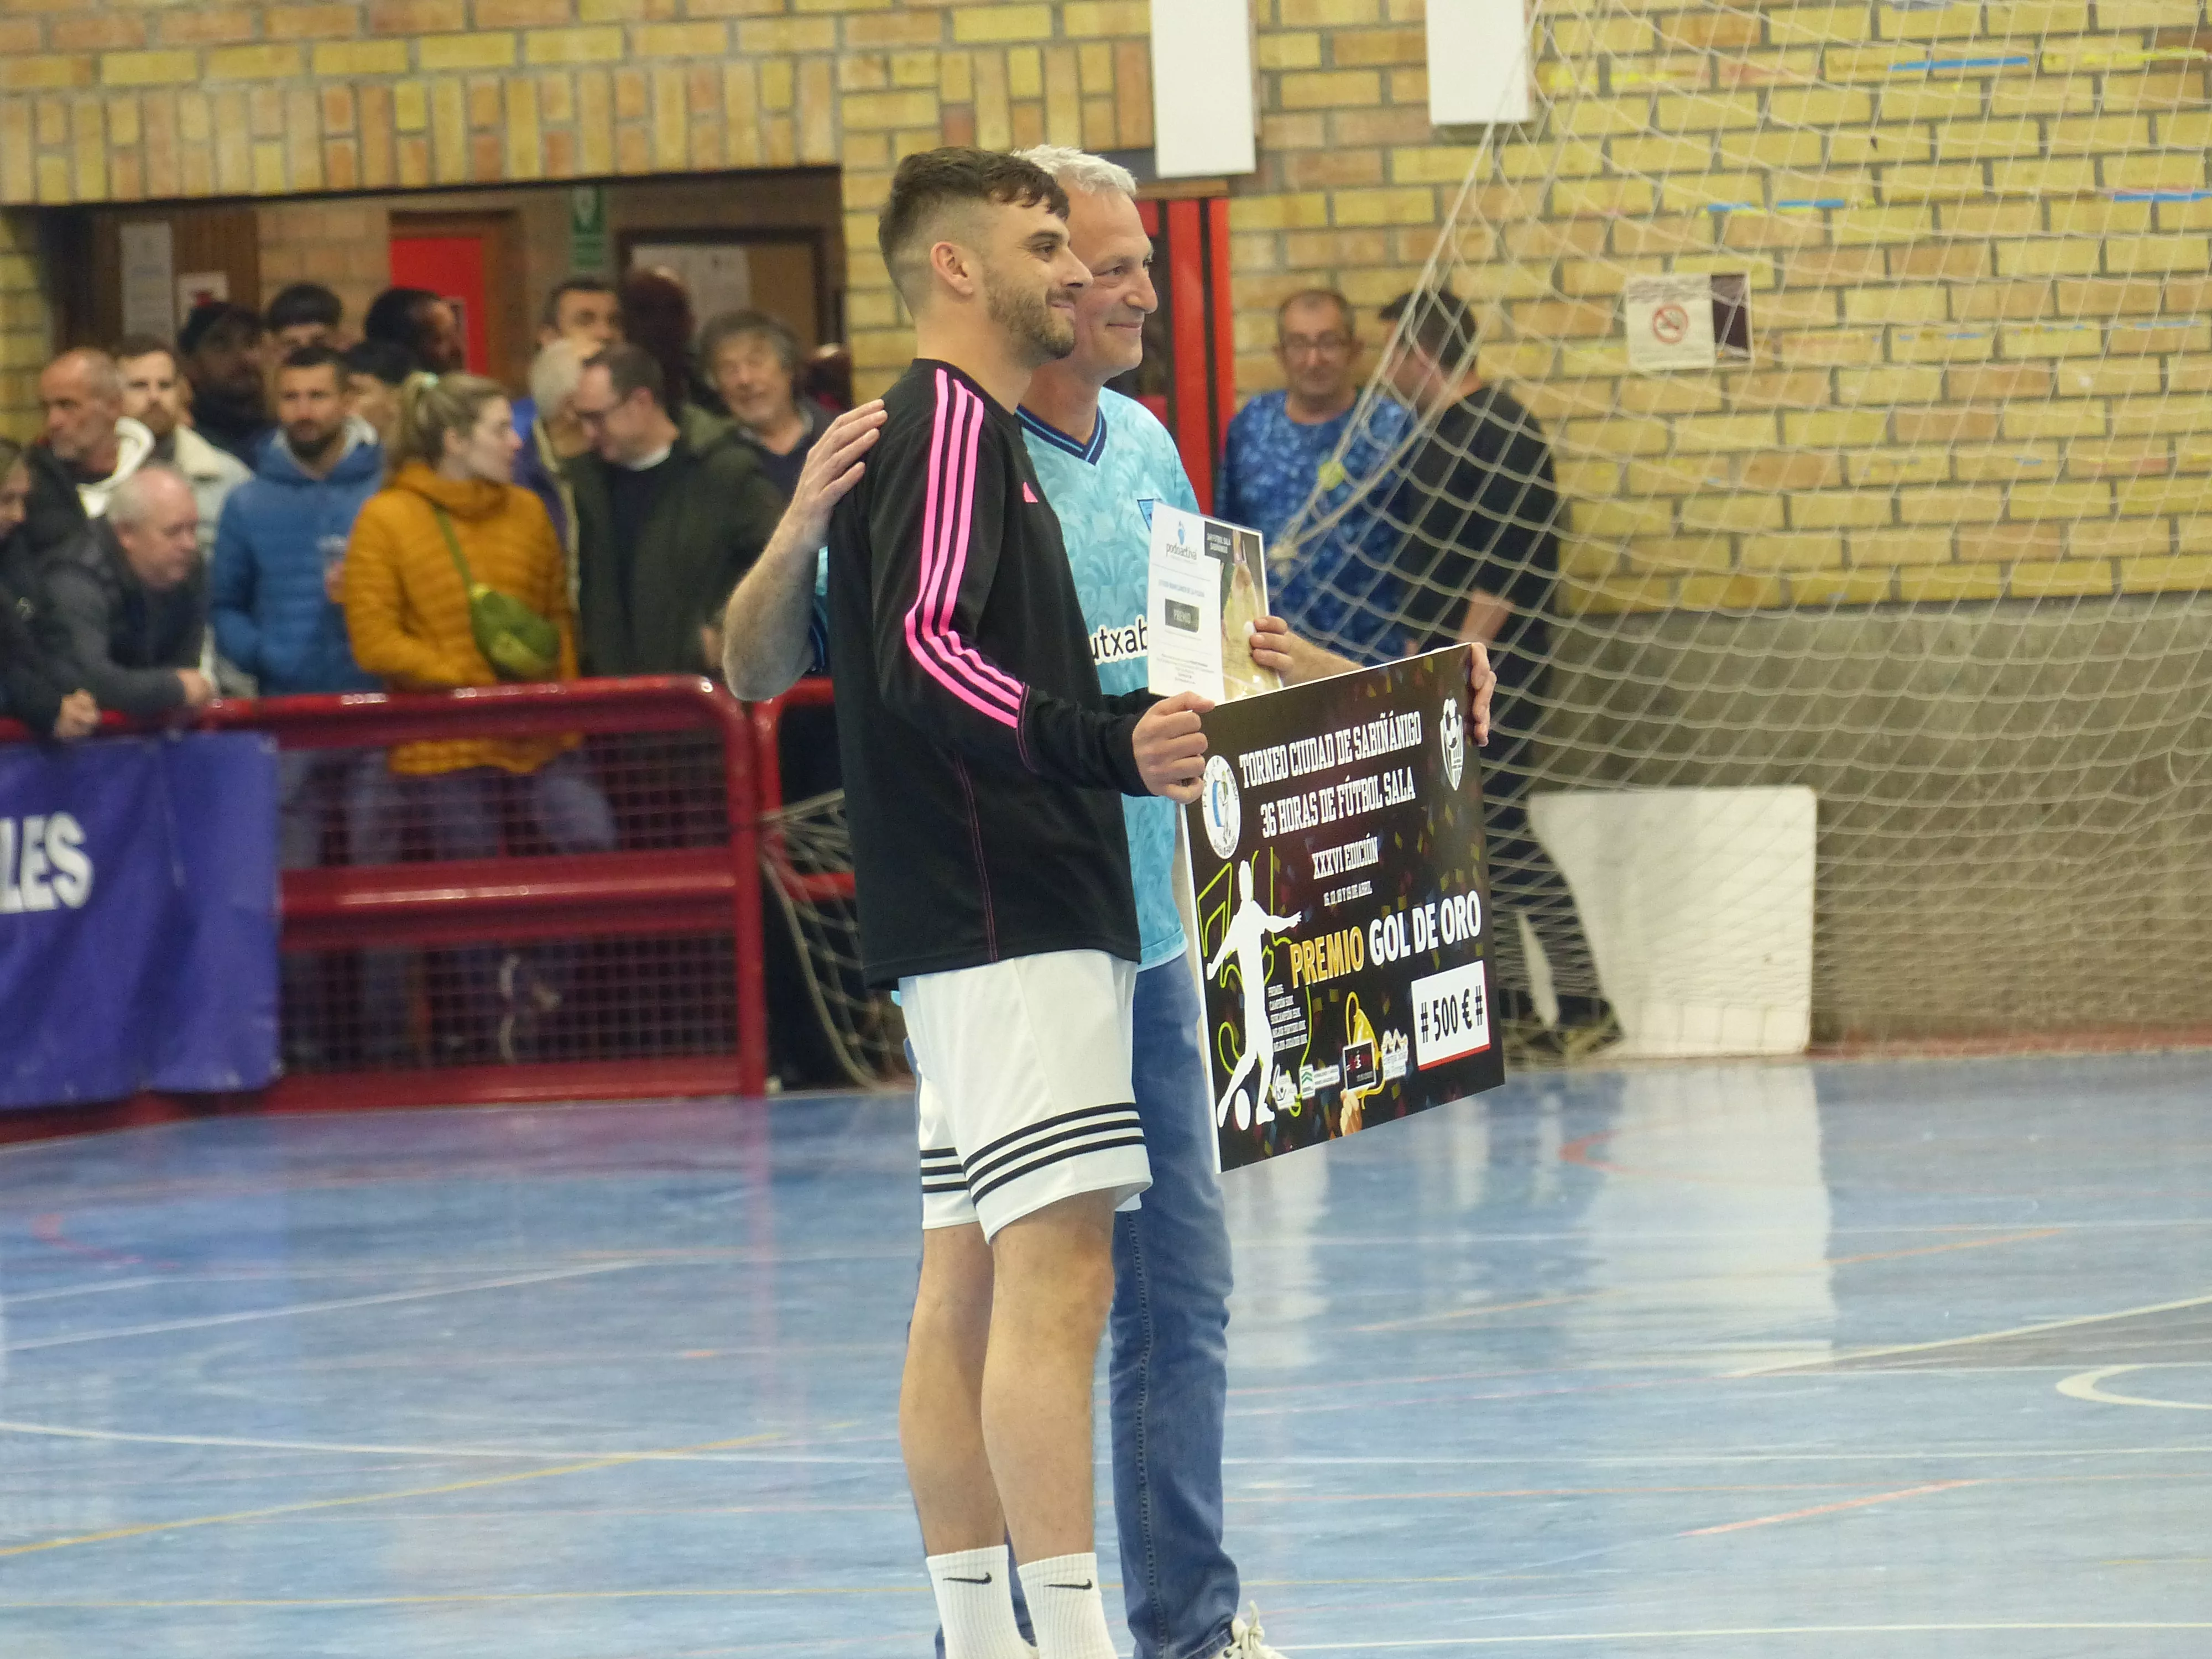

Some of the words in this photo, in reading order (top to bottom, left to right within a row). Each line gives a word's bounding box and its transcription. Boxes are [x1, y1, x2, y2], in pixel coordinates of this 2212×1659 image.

[1166, 542, 1197, 560] podoactiva
[1238, 744, 1289, 789] TORNEO
[1289, 733, 1335, 777] CIUDAD
[1335, 728, 1353, 765] DE
[1353, 709, 1422, 761] SABIÑÁNIGO
[1260, 802, 1277, 839] 36
[1276, 791, 1319, 834] HORAS
[1318, 787, 1337, 824] DE
[1336, 775, 1384, 819] FÚTBOL
[1383, 766, 1416, 807] SALA
[1311, 846, 1344, 880] XXXVI
[1344, 832, 1379, 872] EDICIÓN
[1289, 926, 1364, 989] PREMIO
[1369, 912, 1411, 967] GOL
[1412, 902, 1439, 954] DE
[1440, 890, 1482, 945] ORO
[1420, 1001, 1429, 1044] #
[1432, 994, 1458, 1042] 500
[1462, 988, 1473, 1030] €
[1475, 984, 1483, 1026] #
